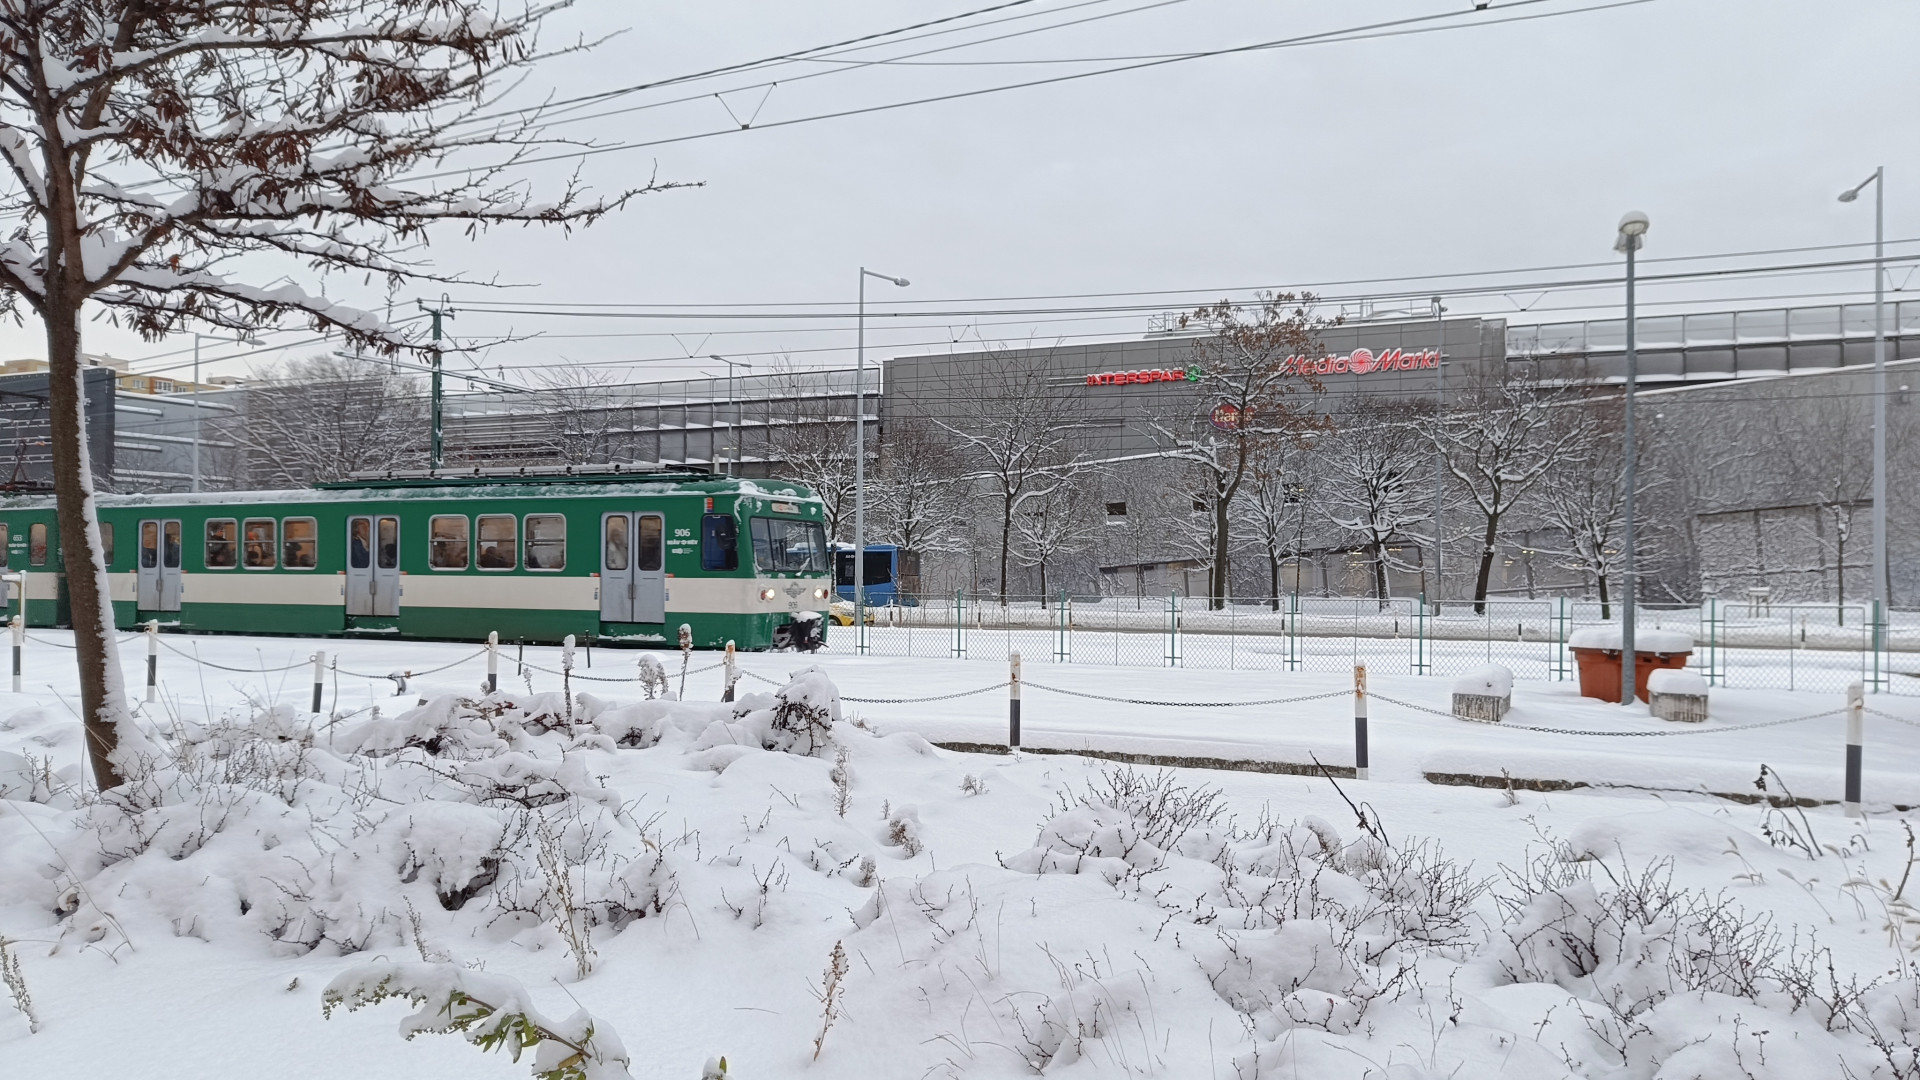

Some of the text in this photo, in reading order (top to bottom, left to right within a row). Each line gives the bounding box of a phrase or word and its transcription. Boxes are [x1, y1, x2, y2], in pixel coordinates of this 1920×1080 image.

[1372, 347, 1440, 372] Markt
[1087, 368, 1185, 386] INTERSPAR
[674, 528, 691, 537] 906
